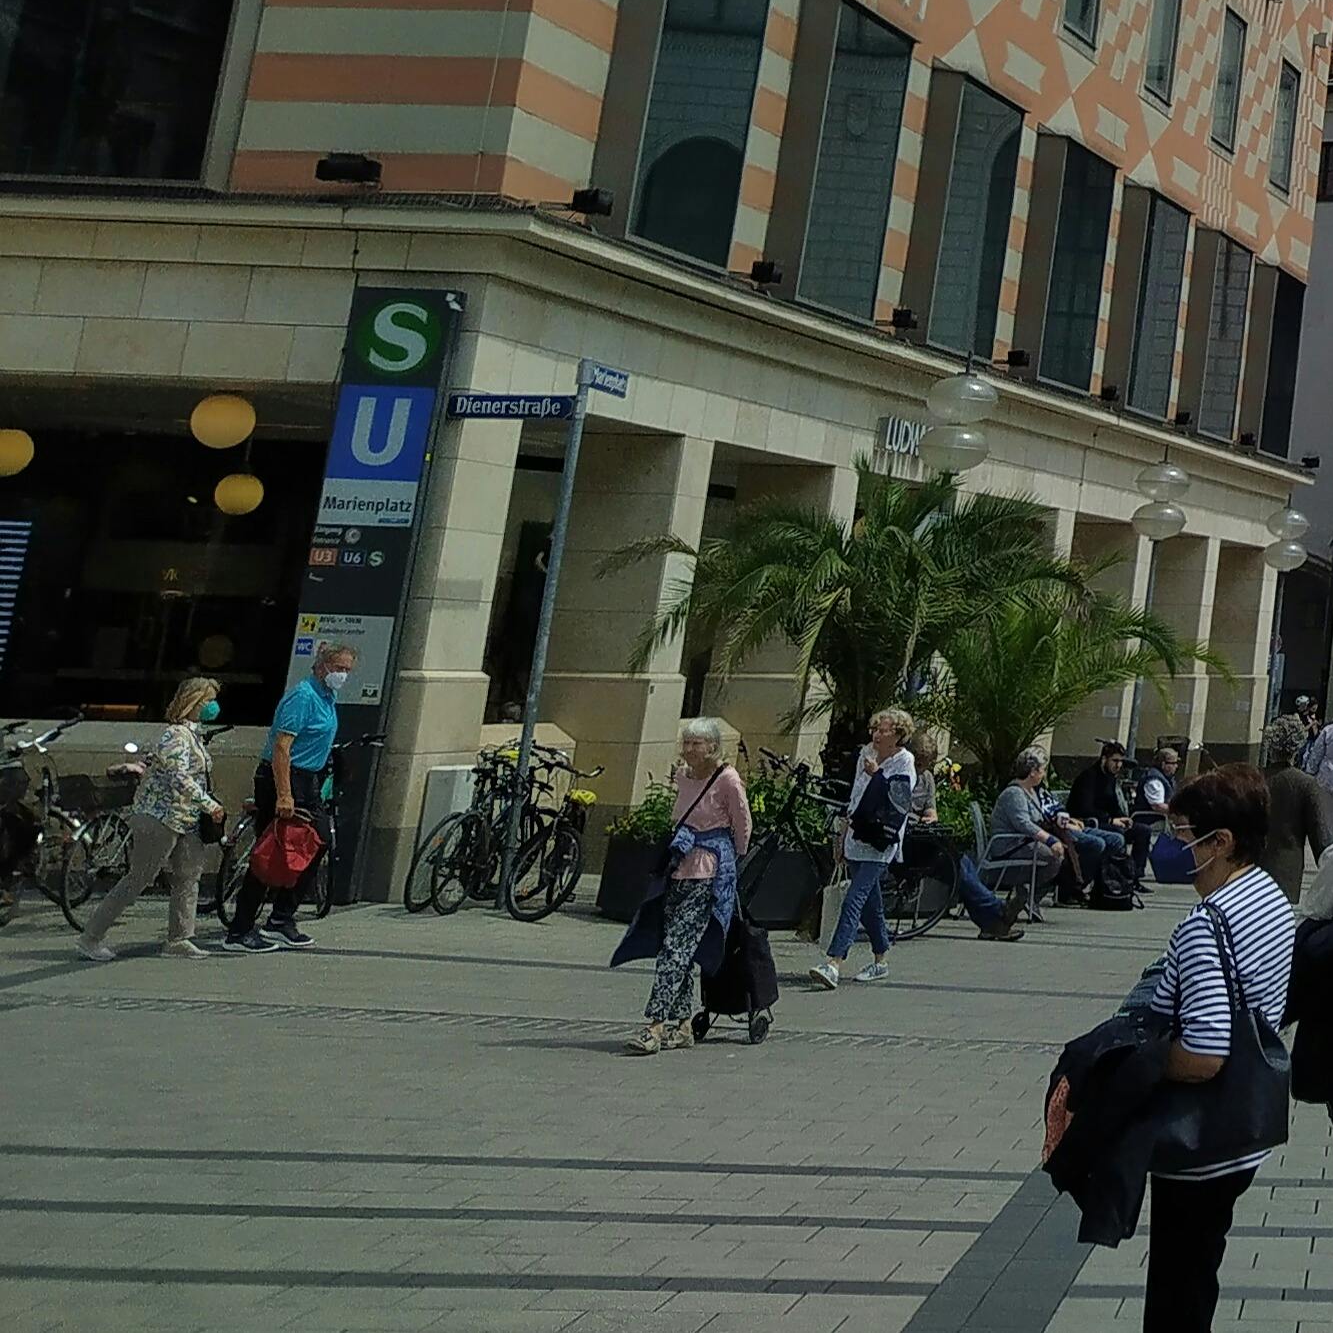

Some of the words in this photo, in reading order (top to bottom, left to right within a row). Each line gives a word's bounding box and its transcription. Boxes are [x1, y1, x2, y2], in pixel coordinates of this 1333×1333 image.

[367, 303, 430, 372] S
[456, 396, 562, 418] Dienerstraße
[350, 396, 413, 466] U
[323, 496, 413, 515] Marienplatz
[314, 551, 332, 562] U3
[343, 552, 362, 564] U6
